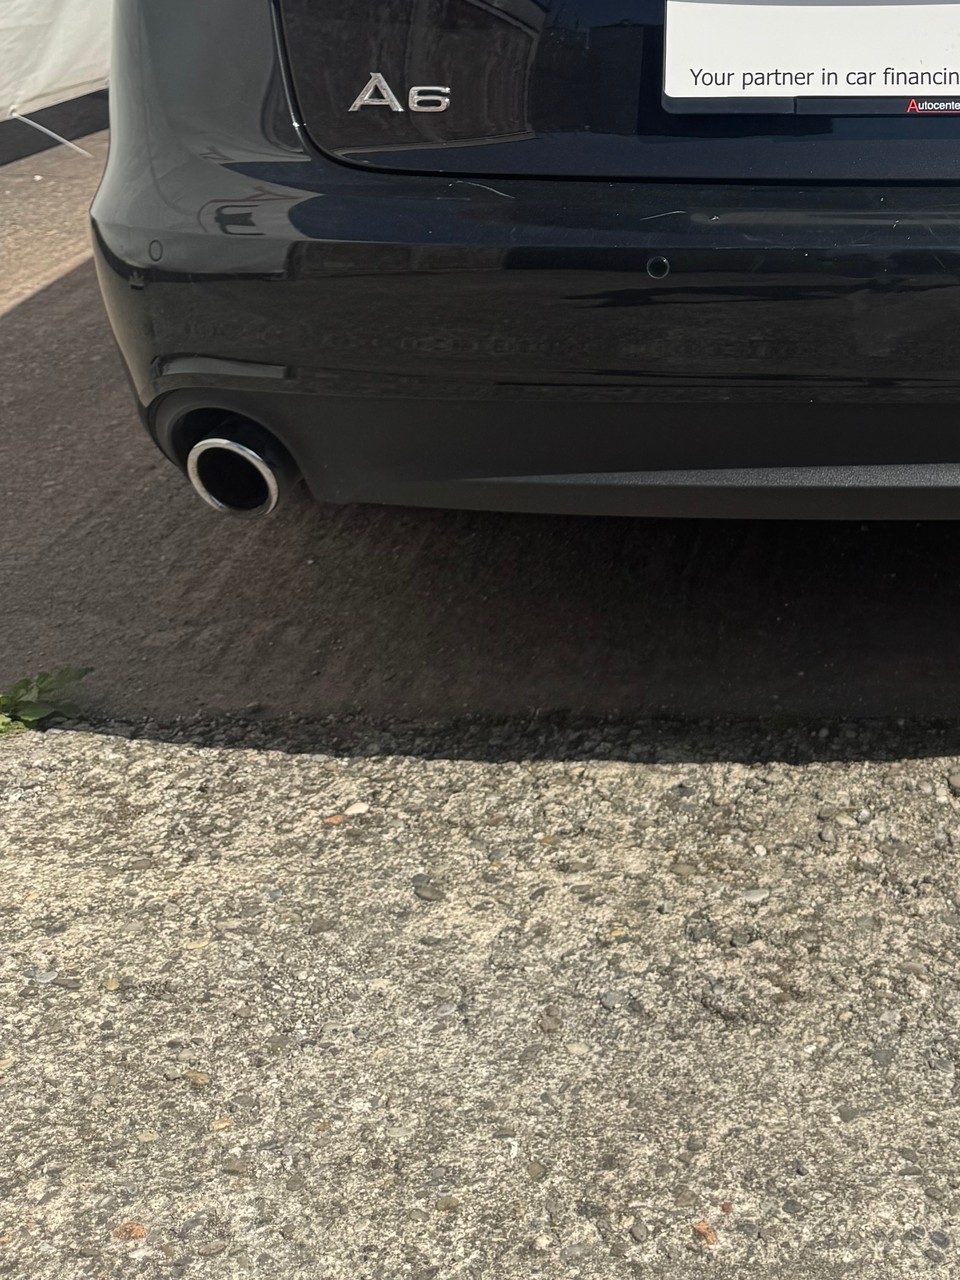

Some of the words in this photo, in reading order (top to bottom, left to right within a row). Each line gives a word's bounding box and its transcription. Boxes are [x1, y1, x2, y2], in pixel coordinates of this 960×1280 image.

[348, 72, 451, 113] A6
[689, 68, 735, 86] Your
[742, 70, 815, 90] partner
[821, 68, 839, 86] in
[846, 70, 877, 86] car
